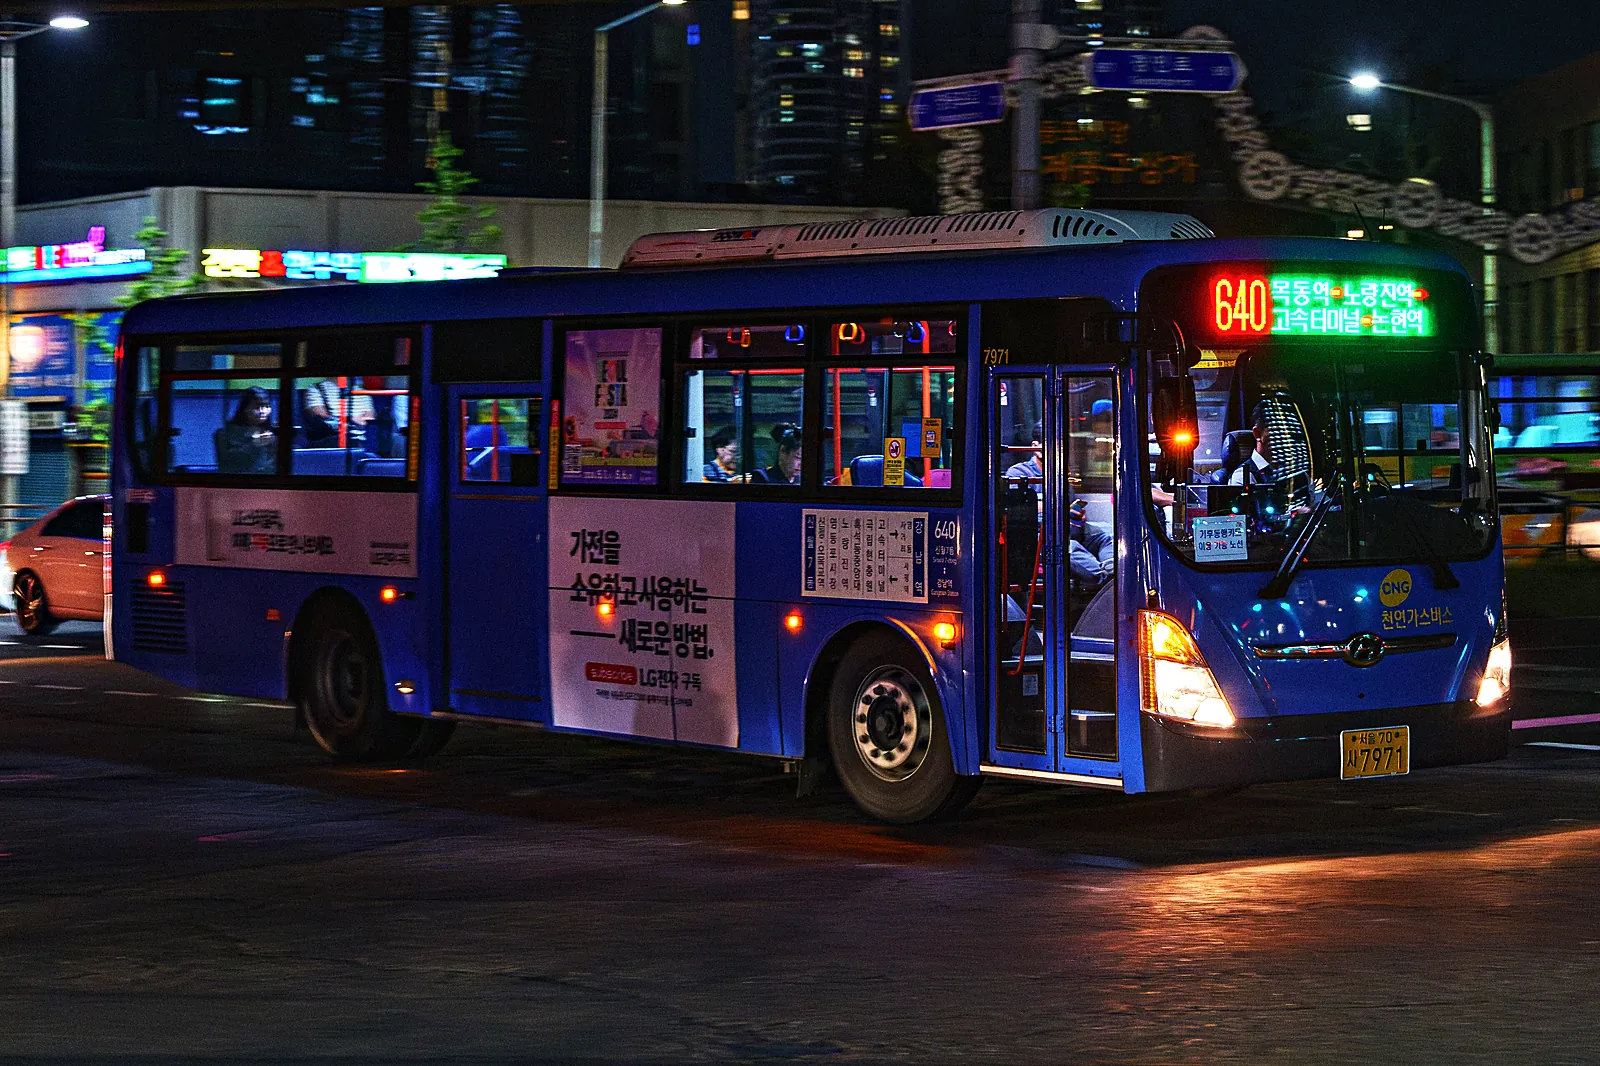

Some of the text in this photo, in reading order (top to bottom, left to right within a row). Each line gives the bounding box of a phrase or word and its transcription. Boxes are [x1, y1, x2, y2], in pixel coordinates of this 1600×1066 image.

[1215, 278, 1267, 331] 640
[1272, 280, 1413, 307] 목동역 노량진역
[1272, 308, 1423, 334] 고속터미널 논현역
[983, 348, 1009, 365] 7971
[934, 520, 956, 539] 640
[1199, 528, 1242, 539] 기후동행카드
[569, 528, 622, 565] 가전을
[829, 517, 837, 590] 영등포시장
[841, 518, 849, 590] 노량진역
[865, 518, 874, 593] 국립현충원
[878, 519, 886, 593] 고속터미널
[914, 520, 923, 596] 강남역
[1198, 540, 1243, 551] 이용 가능 노선
[570, 573, 708, 614] 소유하고 사용하는
[936, 578, 953, 589] 강남역
[1382, 579, 1410, 595] CNG
[1382, 607, 1454, 630] 천연가스버스
[619, 618, 672, 654] 새로운
[639, 668, 702, 692] LG전자 구독
[1360, 731, 1392, 745] 서울 70
